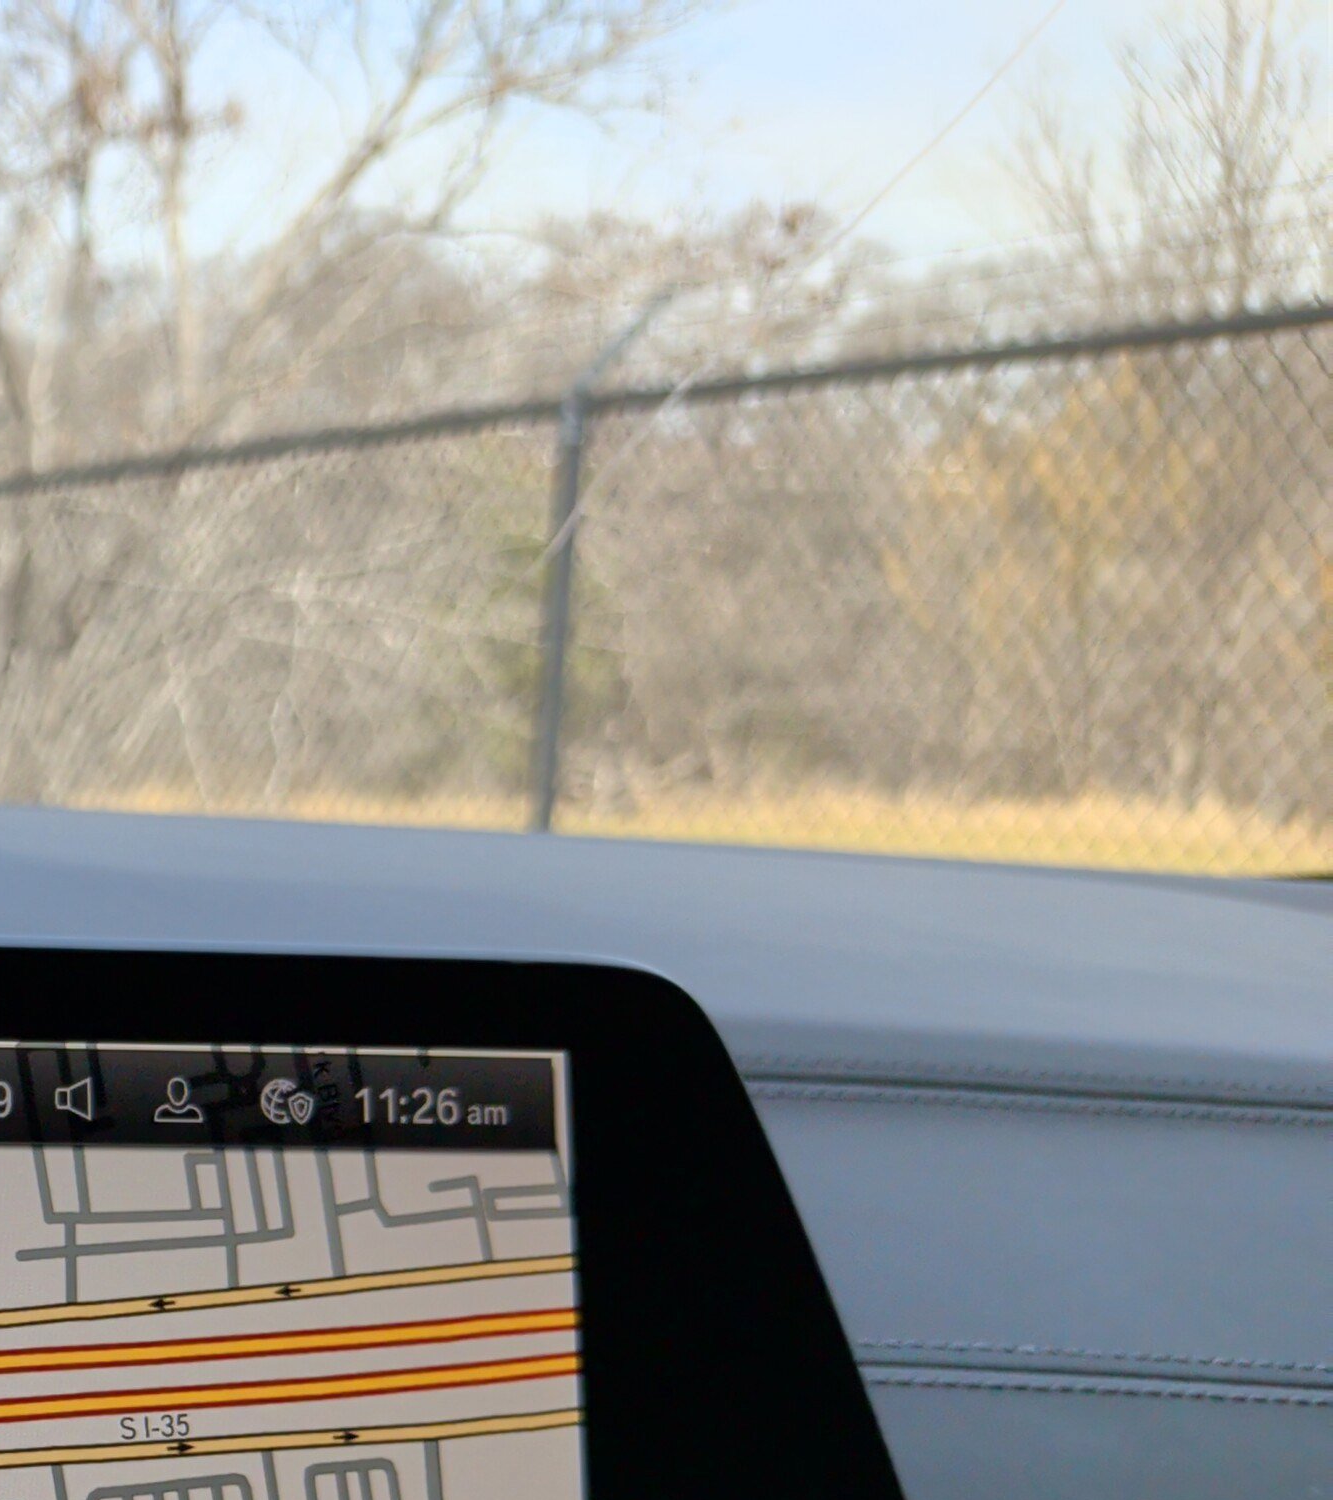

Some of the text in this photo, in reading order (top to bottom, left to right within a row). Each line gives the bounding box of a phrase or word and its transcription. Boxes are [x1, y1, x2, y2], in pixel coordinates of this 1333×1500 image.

[353, 1085, 509, 1127] 11:26 am
[119, 1413, 190, 1440] S I-35
